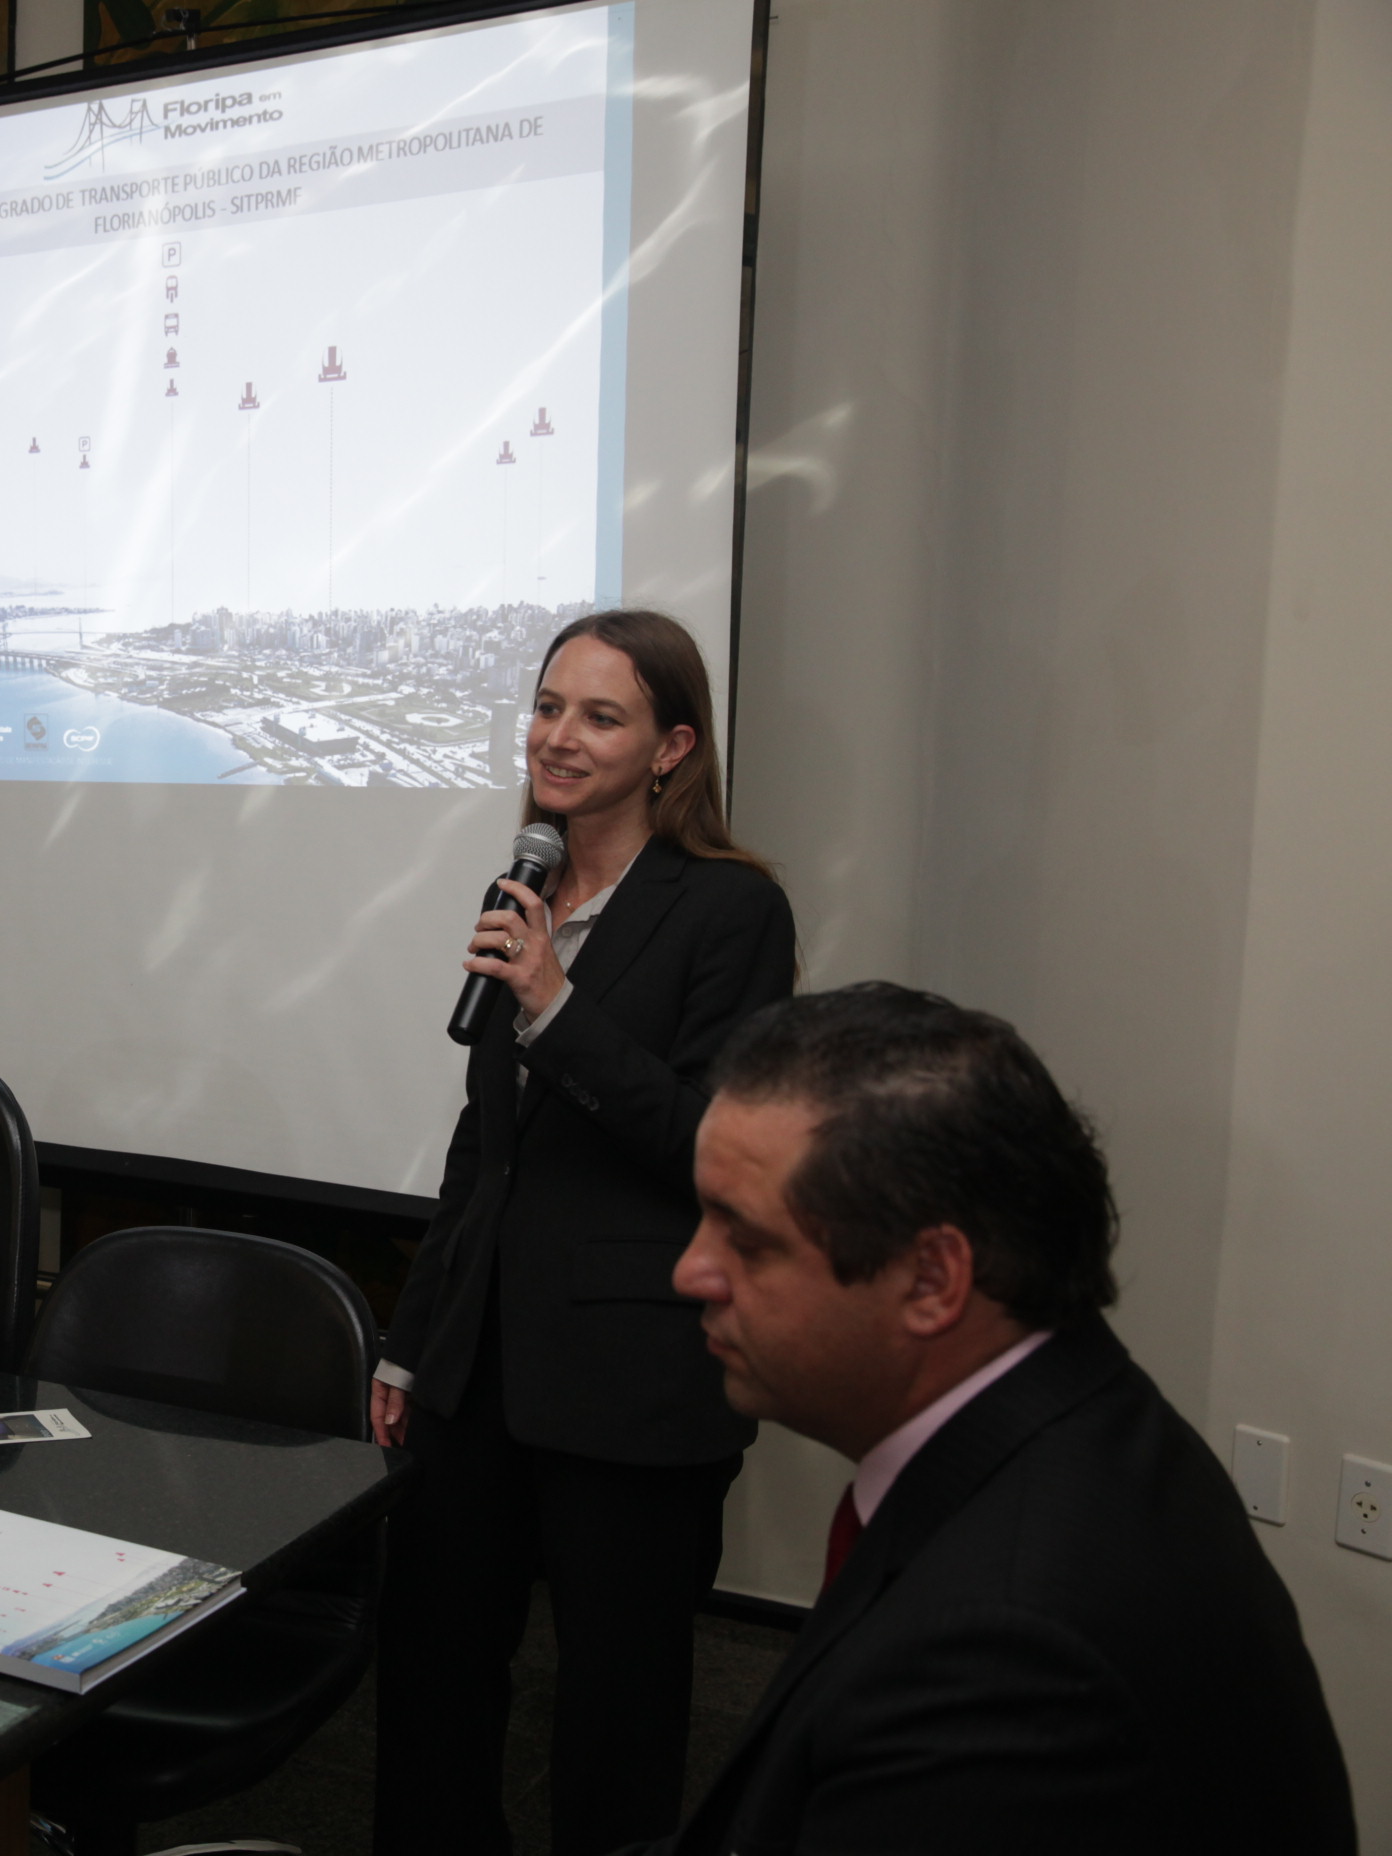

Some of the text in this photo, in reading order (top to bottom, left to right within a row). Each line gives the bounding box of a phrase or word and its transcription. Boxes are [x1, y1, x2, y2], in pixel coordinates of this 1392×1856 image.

[163, 91, 282, 120] Floripa em
[164, 108, 284, 140] Movimento
[55, 192, 74, 210] DE
[80, 176, 180, 207] TRANSPORTE
[183, 163, 253, 192] PÚBLICO
[259, 159, 282, 180] DA
[287, 145, 353, 176] REGIÃO
[357, 121, 513, 164] METROPOLITANA
[519, 116, 544, 139] DE
[94, 200, 216, 234] FLORIANÓPOLIS
[230, 186, 302, 215] SITPRMF
